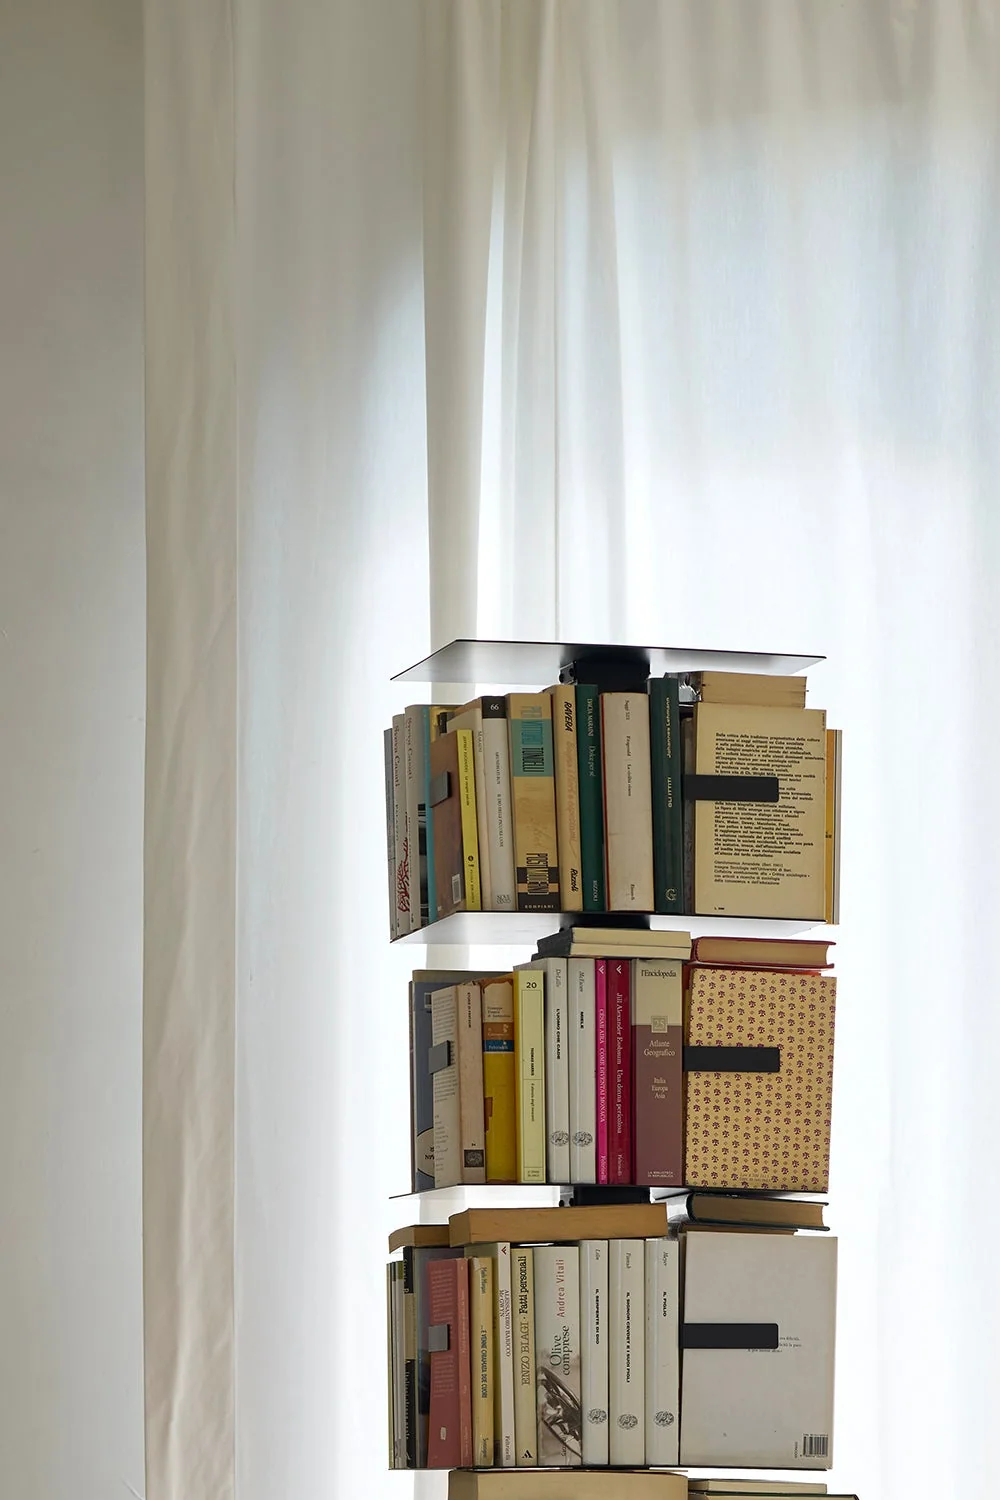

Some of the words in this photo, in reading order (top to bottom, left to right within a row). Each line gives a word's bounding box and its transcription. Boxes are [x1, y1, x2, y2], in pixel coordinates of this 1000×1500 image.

[564, 702, 574, 732] RAVERA
[588, 745, 596, 760] Dolce
[570, 868, 578, 892] Rizzoli
[640, 969, 677, 978] l'Enciclopedia
[616, 1004, 624, 1036] Alexander
[653, 1019, 665, 1029] 25
[643, 1049, 676, 1057] Geografico
[651, 1085, 668, 1093] Europa
[616, 1104, 624, 1134] pericolosa
[518, 1256, 529, 1294] personali
[556, 1259, 564, 1284] Vitali
[503, 1289, 511, 1330] ALESSANDRO
[519, 1294, 528, 1314] Fatti
[556, 1287, 565, 1318] Andrea
[521, 1321, 530, 1354] BIAGI
[548, 1335, 562, 1366] Olive
[560, 1325, 573, 1376] comprese
[522, 1356, 531, 1385] ENZO
